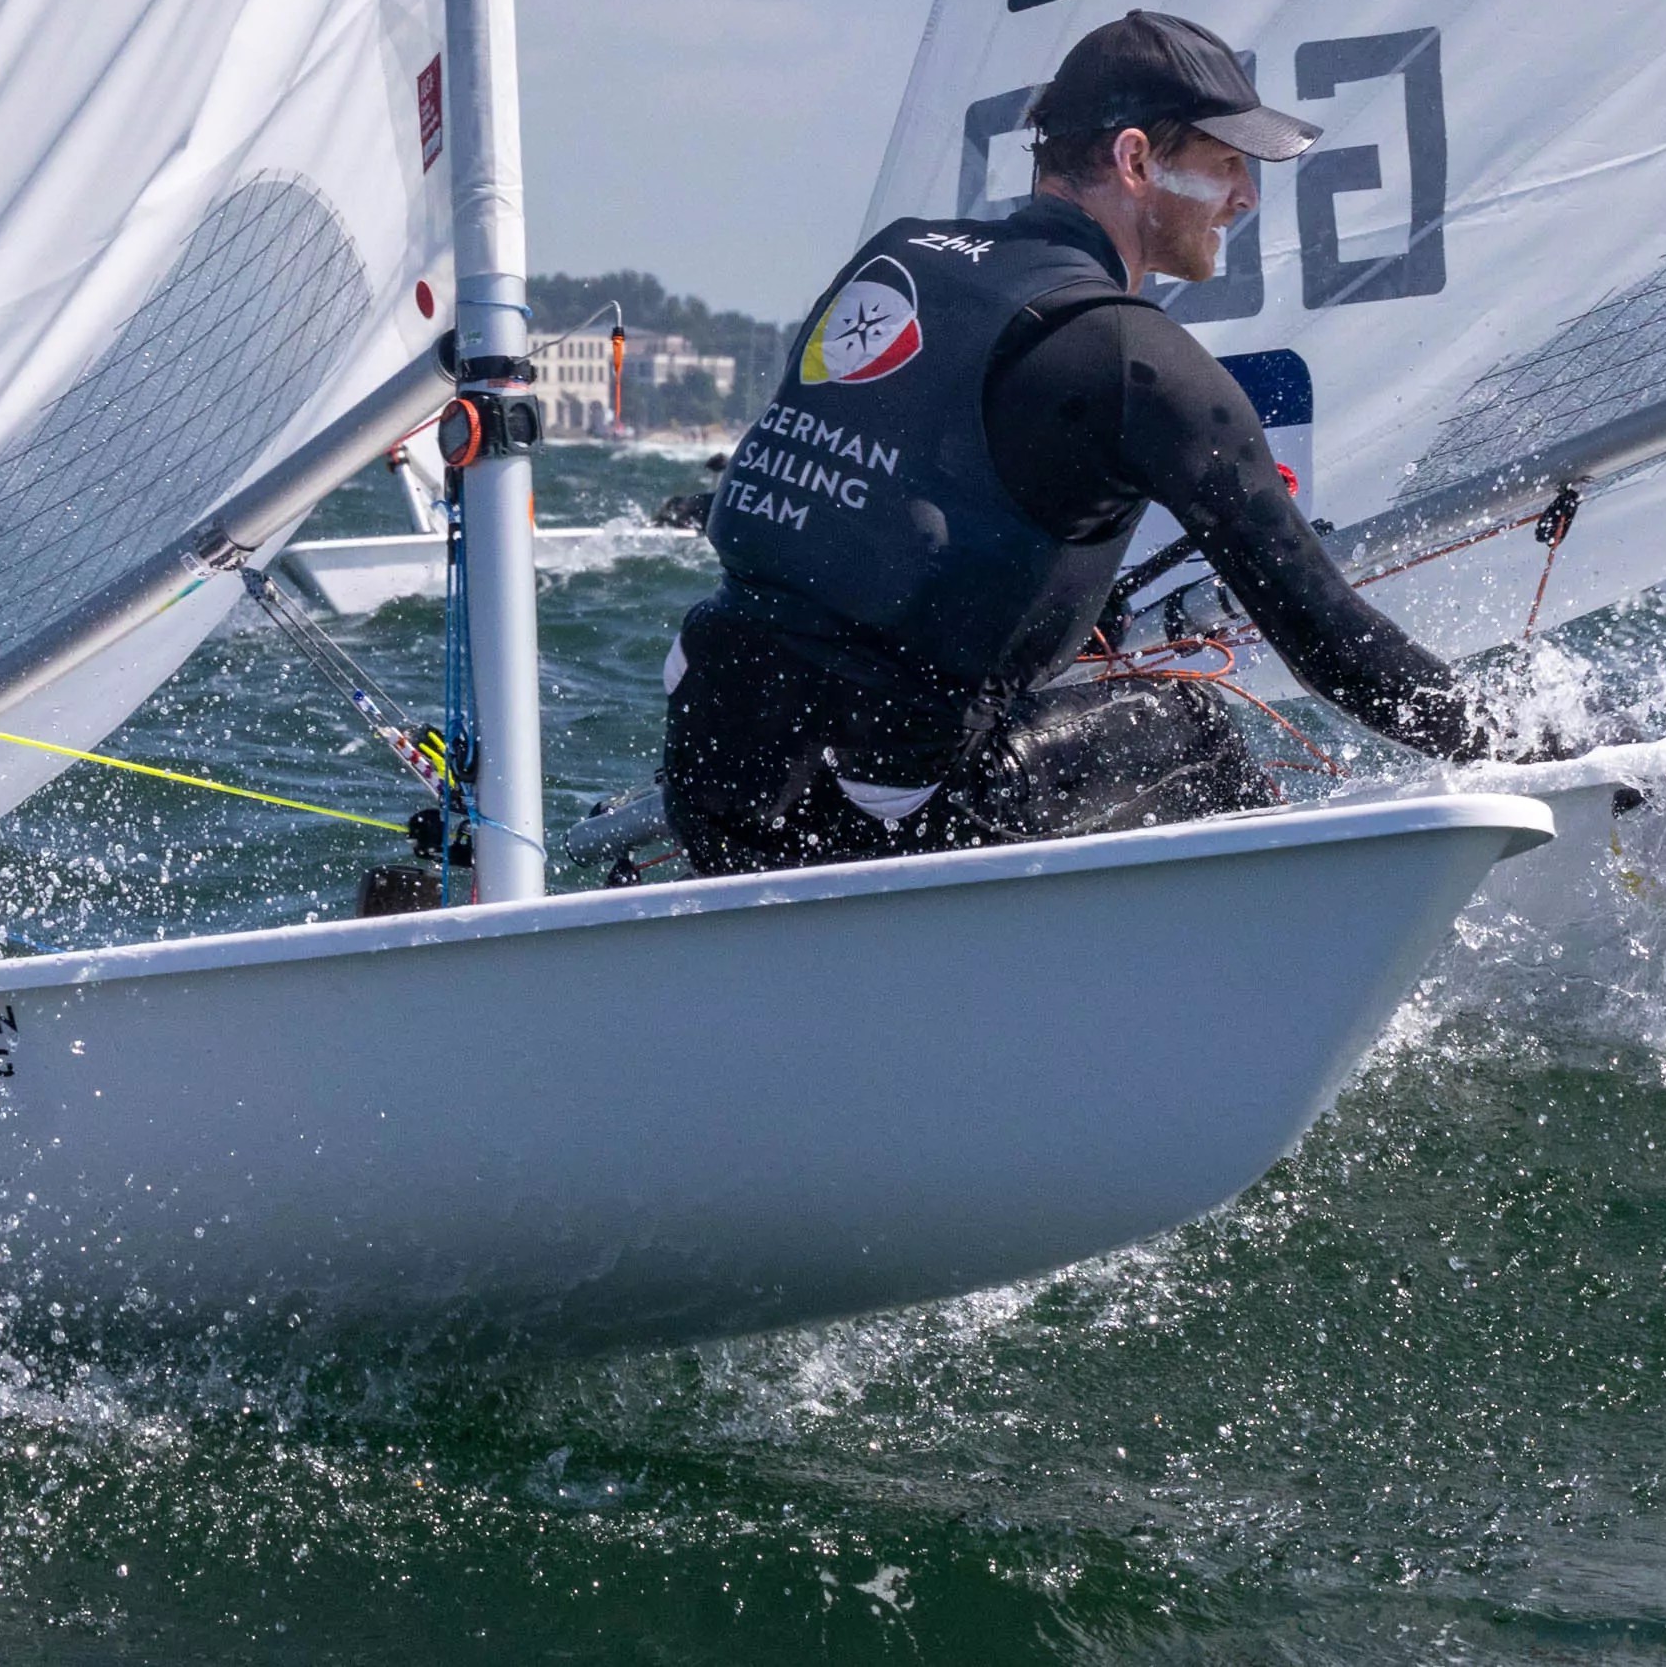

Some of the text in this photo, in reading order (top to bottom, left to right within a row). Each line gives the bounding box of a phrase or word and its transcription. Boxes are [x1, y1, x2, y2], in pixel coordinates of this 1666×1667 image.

[760, 402, 901, 477] GERMAN
[725, 479, 810, 530] TEAM
[738, 441, 869, 510] SAILING
